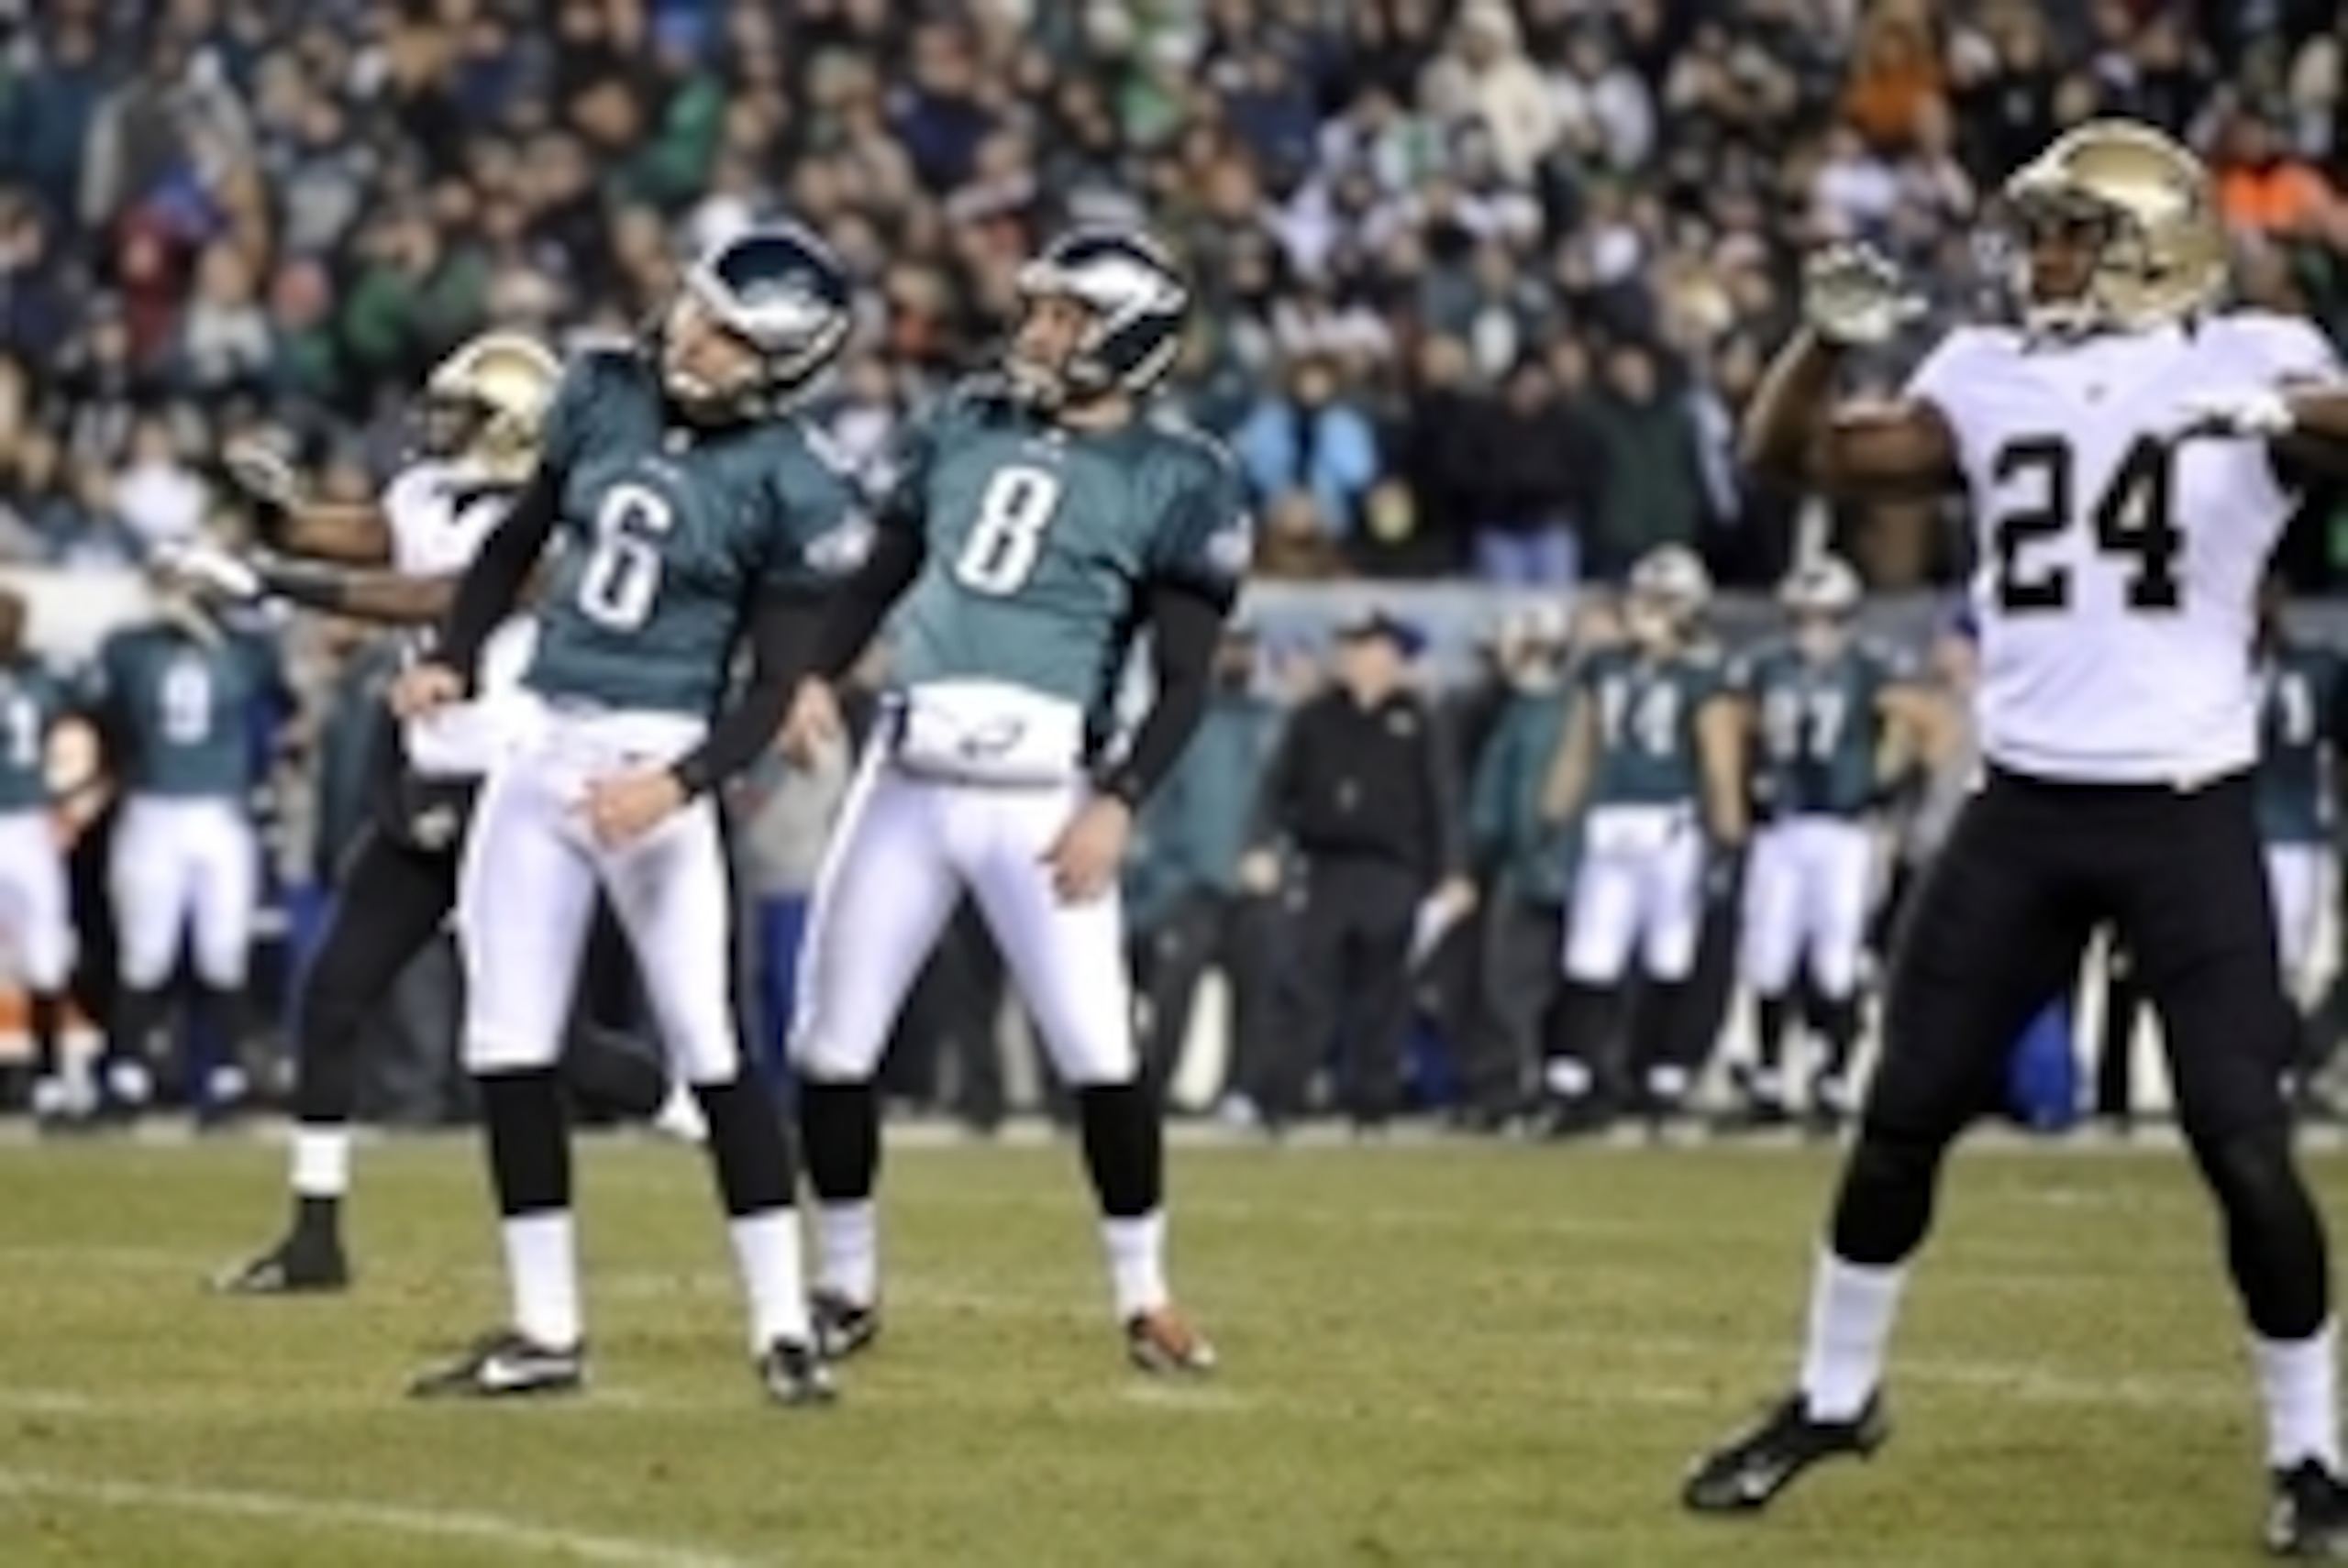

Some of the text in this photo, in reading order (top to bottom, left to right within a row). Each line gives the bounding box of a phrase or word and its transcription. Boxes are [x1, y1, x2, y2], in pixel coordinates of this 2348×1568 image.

[579, 480, 670, 633] 6
[955, 466, 1058, 596] 8
[1993, 432, 2186, 613] 24
